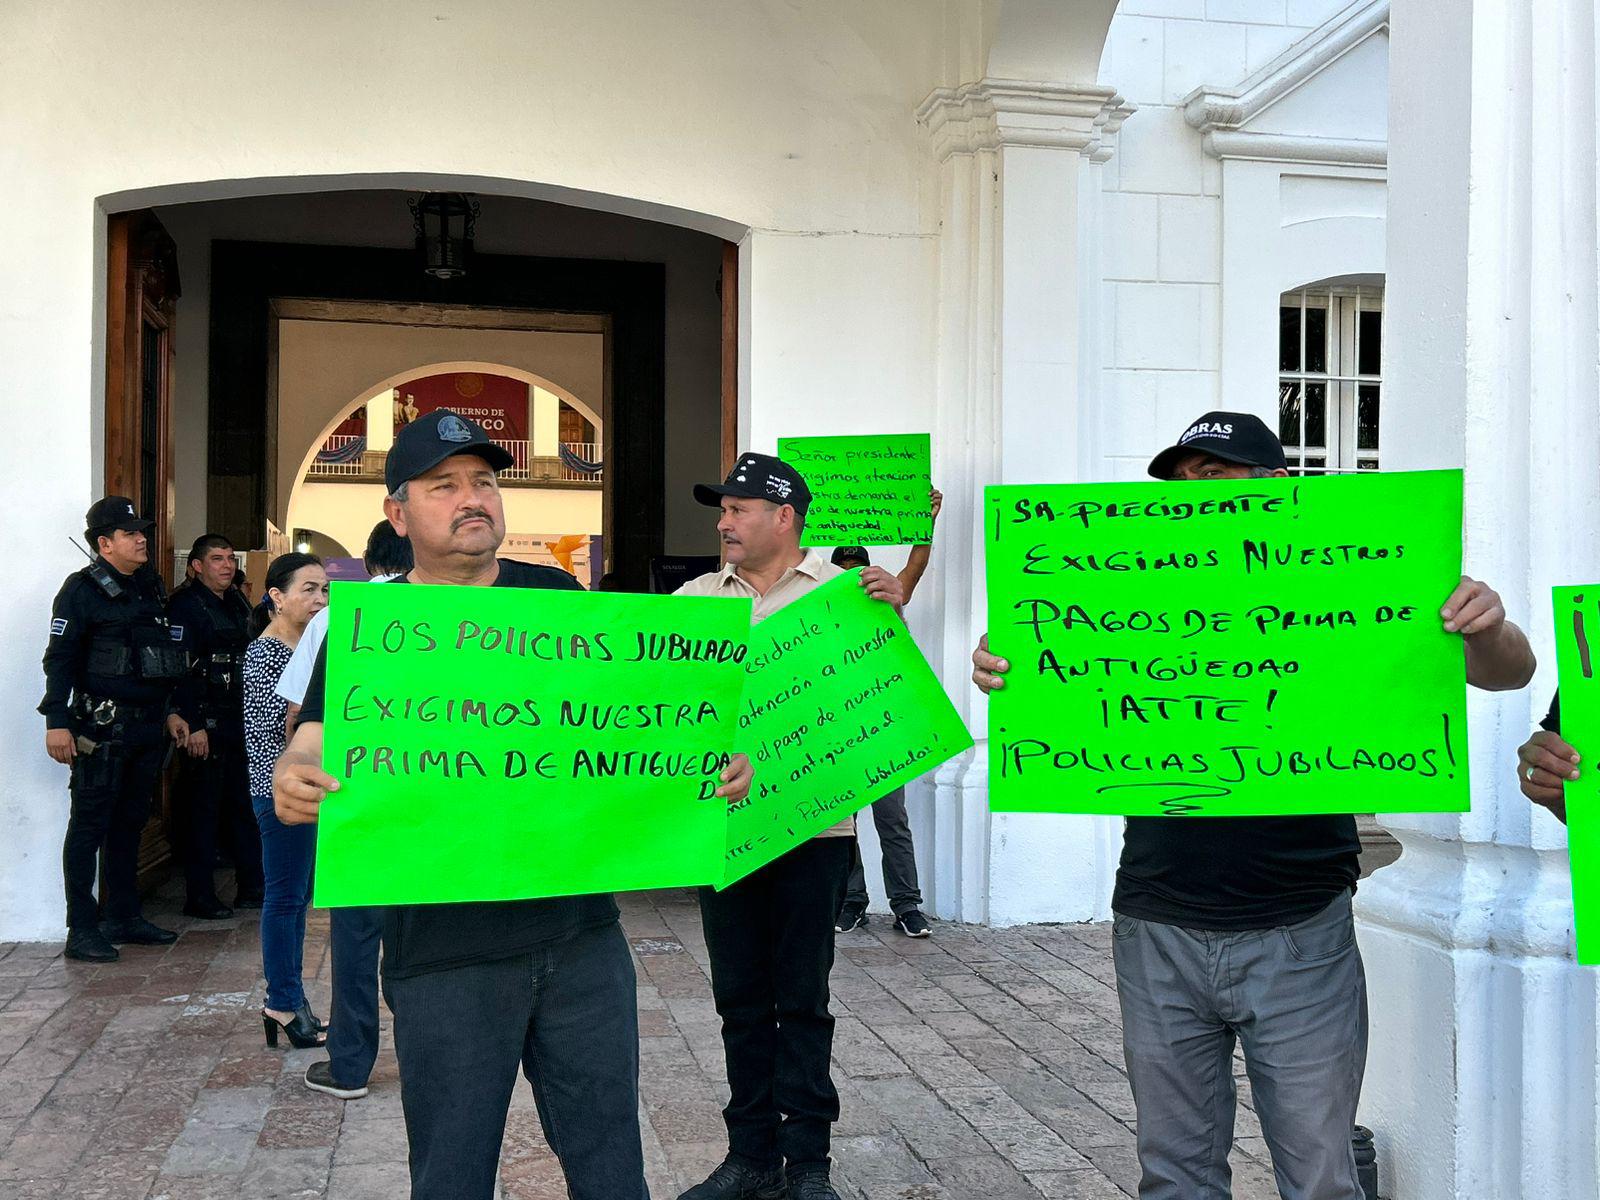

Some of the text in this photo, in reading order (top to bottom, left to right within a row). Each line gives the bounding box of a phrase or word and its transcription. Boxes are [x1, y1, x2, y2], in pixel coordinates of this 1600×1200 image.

[435, 406, 505, 416] BIERNO DE
[1181, 422, 1233, 441] OBRAS
[785, 442, 836, 462] Señor
[803, 474, 859, 485] xigimos
[846, 491, 897, 500] demanda
[904, 493, 915, 502] el
[809, 507, 821, 515] go
[846, 507, 892, 516] nuestra
[1024, 539, 1405, 575] EXIGIMOS NUESTROS
[351, 608, 436, 653] LOS
[1014, 599, 1418, 643] PAGOS DE PRIMA DE
[822, 665, 836, 677] a
[843, 626, 896, 666] nuestra
[343, 685, 720, 729] EXIGIMOS NUESTRA
[757, 674, 903, 762] el pago de nuestra
[1217, 713, 1455, 783] JUBILADOS!
[345, 746, 486, 778] PRIMA
[505, 751, 557, 778] DE
[698, 780, 715, 800] D
[759, 784, 780, 799] de
